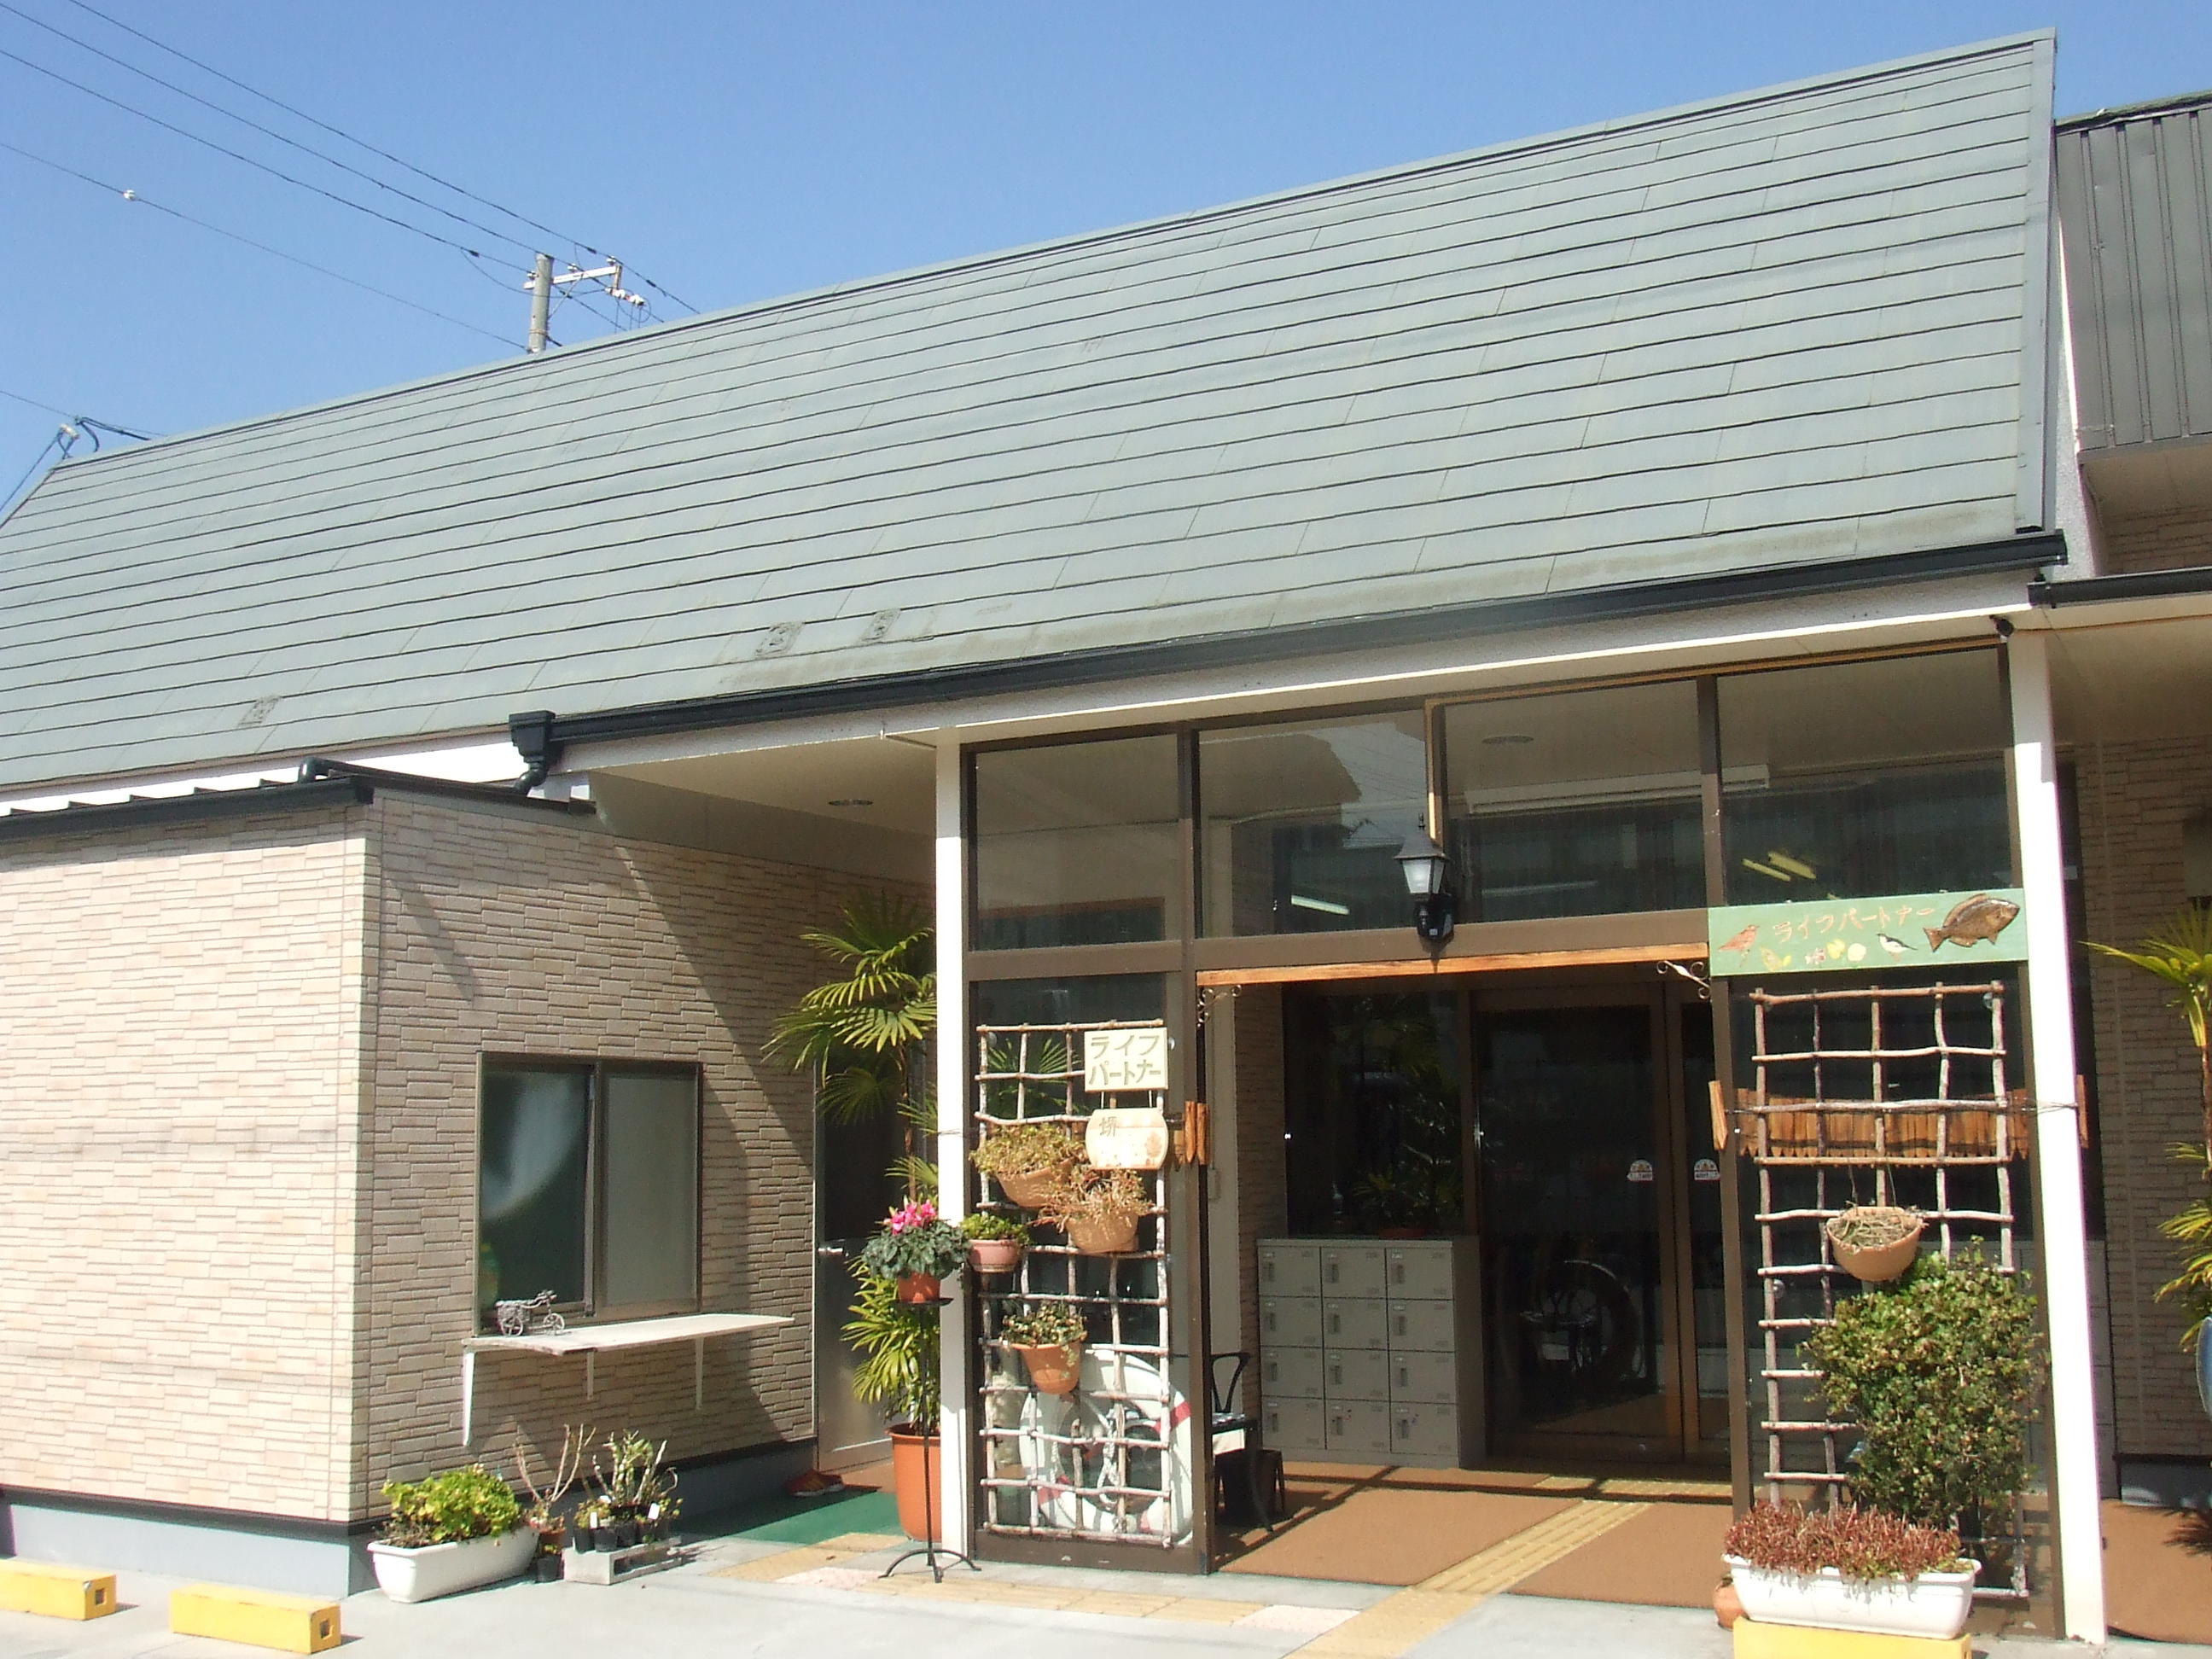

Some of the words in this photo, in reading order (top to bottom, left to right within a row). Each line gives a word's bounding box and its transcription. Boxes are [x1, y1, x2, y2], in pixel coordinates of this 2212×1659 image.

[1773, 905, 1936, 943] ライフパートナー
[1091, 1034, 1161, 1060] ライフ
[1088, 1059, 1161, 1086] パートナー
